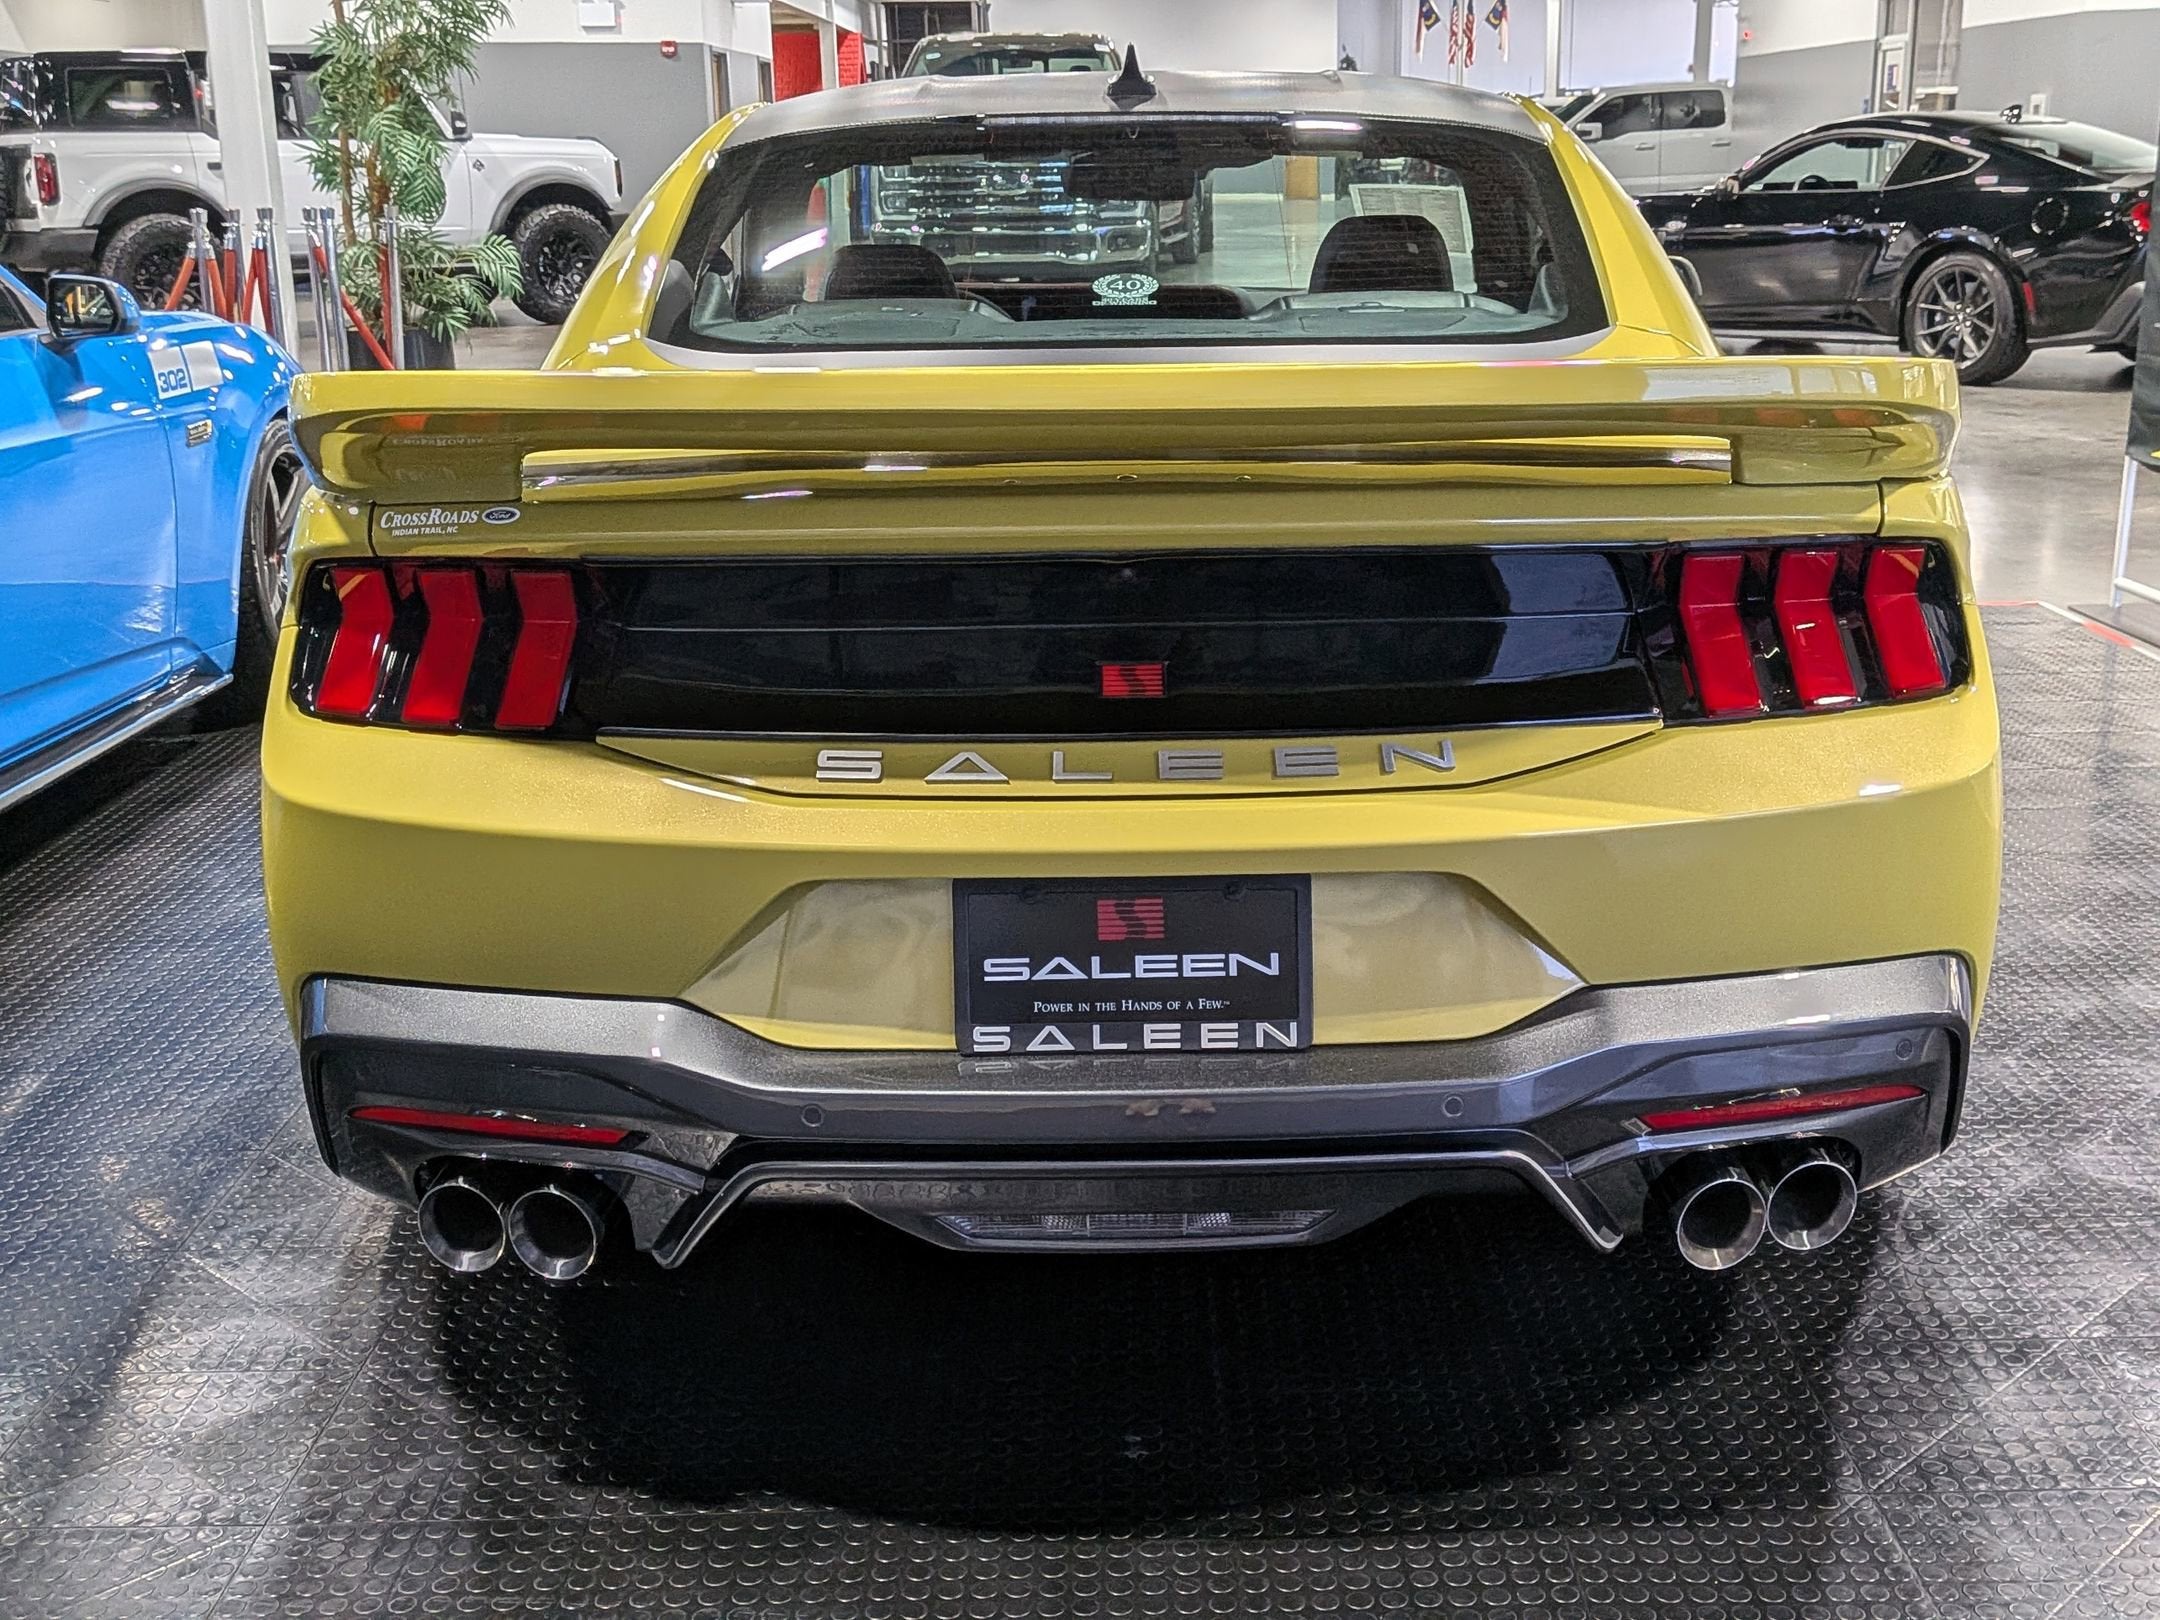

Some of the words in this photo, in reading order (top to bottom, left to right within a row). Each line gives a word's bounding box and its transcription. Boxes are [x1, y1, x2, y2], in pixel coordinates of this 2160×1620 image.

[1110, 280, 1141, 290] 40
[158, 368, 188, 393] 302
[391, 527, 419, 537] INDIAN
[816, 740, 1456, 783] SALEEN
[983, 952, 1279, 982] SALEEN
[973, 1022, 1298, 1053] SALEEN
